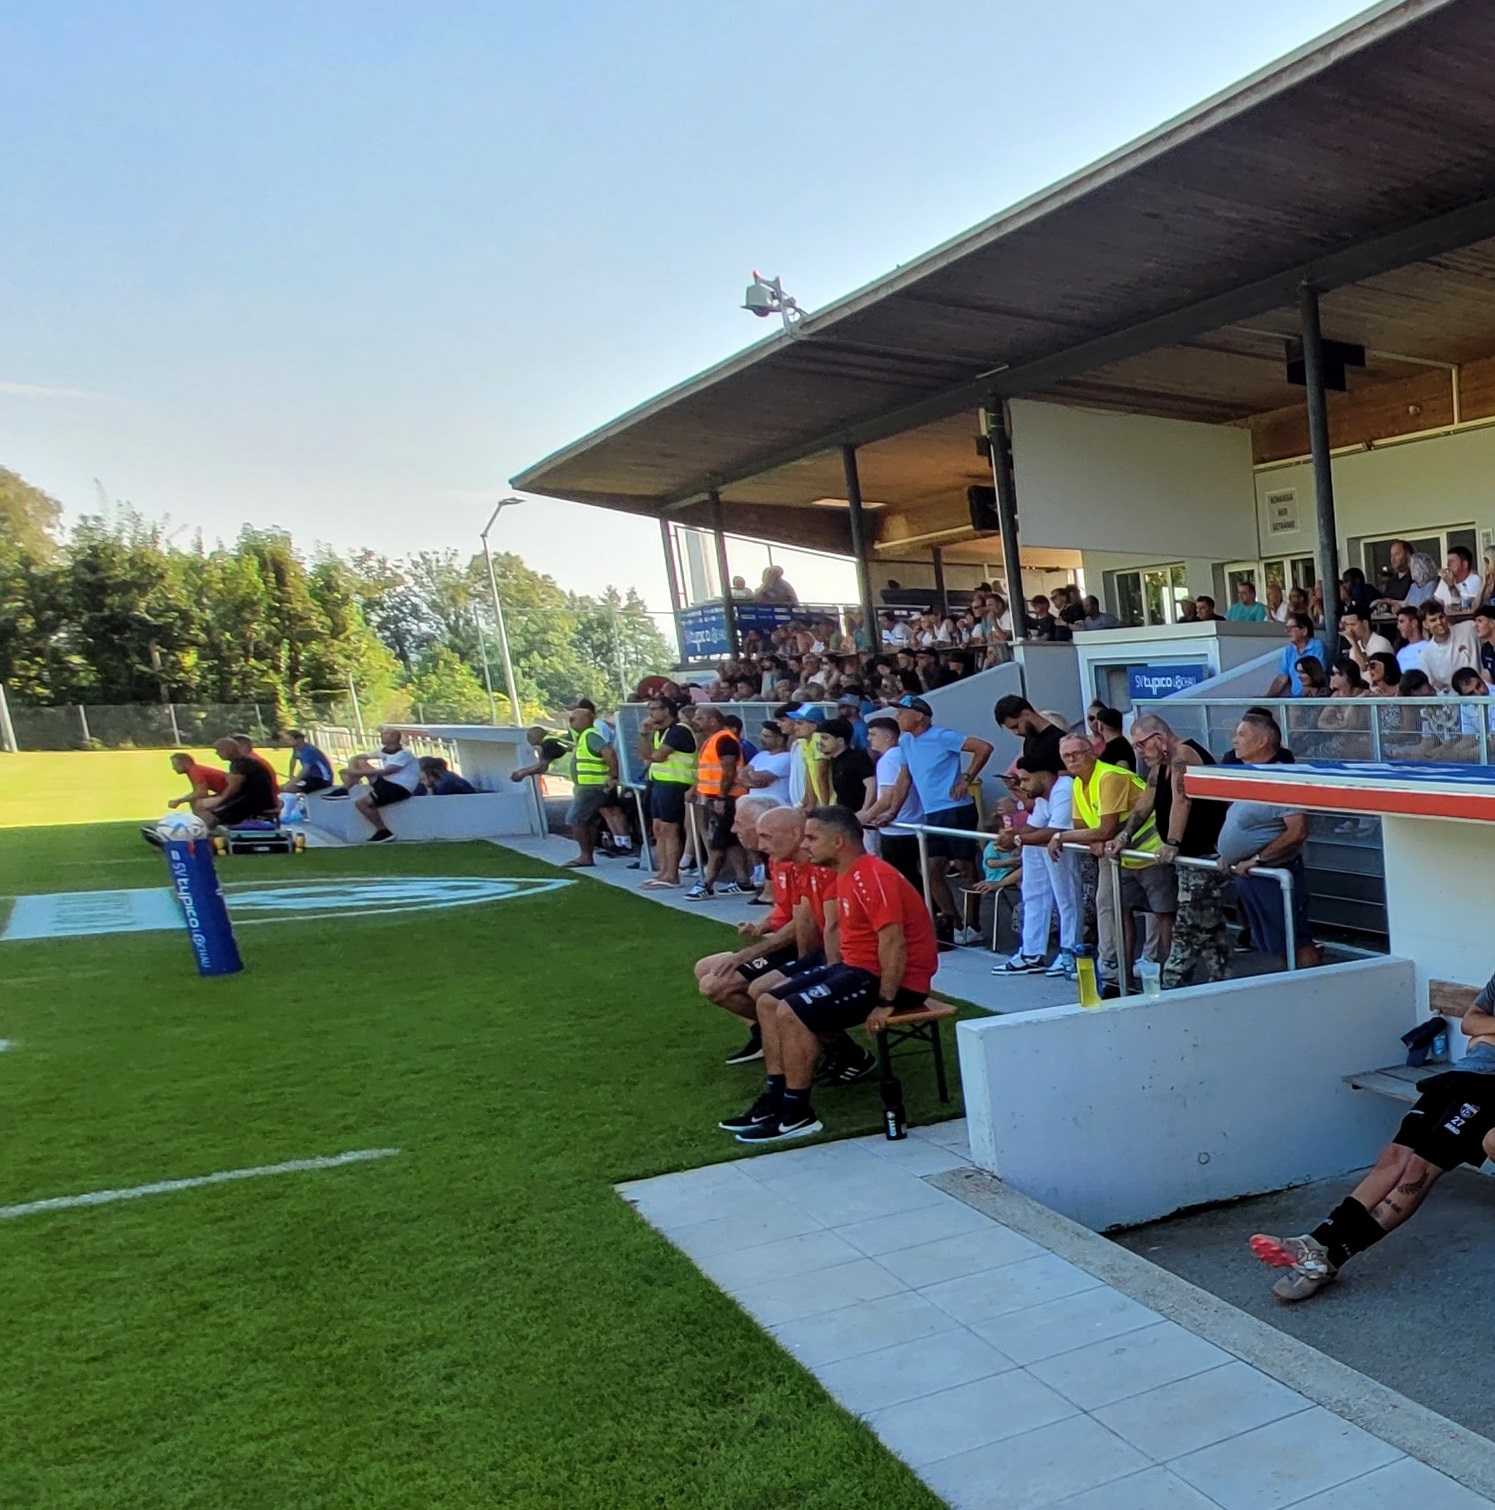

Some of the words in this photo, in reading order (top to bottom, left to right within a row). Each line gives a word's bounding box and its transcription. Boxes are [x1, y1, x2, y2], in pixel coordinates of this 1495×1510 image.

[1144, 674, 1173, 695] typico
[171, 862, 188, 877] SV
[176, 877, 200, 928] typico
[1450, 1115, 1466, 1126] 27
